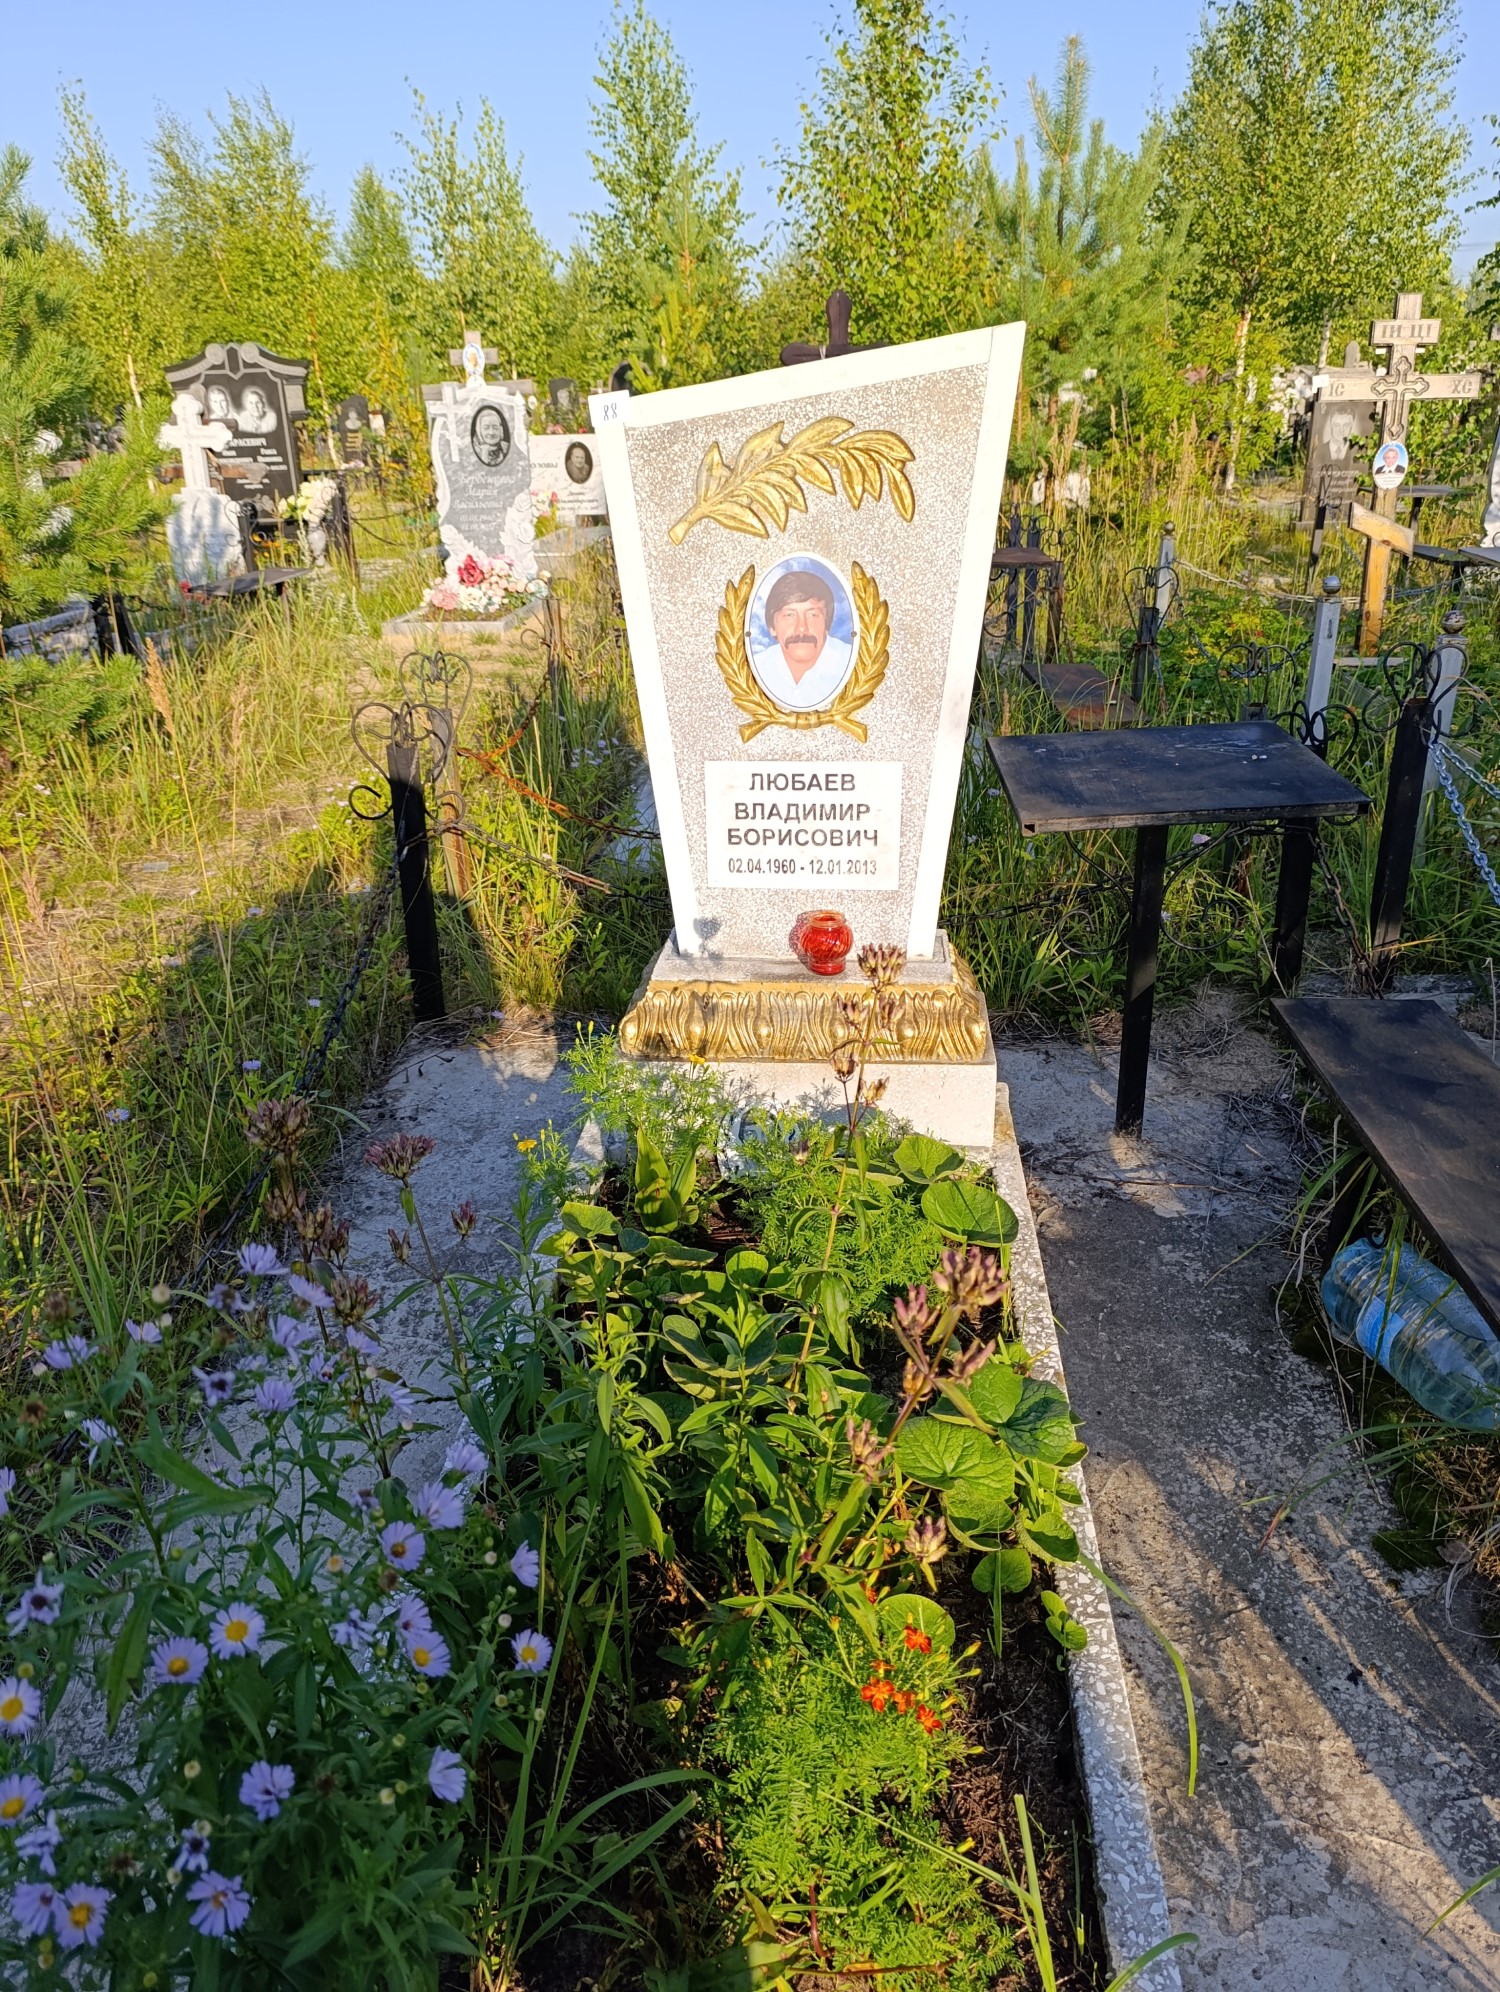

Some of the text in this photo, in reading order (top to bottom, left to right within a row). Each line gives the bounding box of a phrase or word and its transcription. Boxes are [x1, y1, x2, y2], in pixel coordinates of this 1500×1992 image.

[603, 402, 618, 421] 88
[749, 773, 855, 791] ЛЮБАЕВ
[735, 803, 870, 824] ВЛАДИМИР
[728, 828, 877, 846] БОРИСОВИЧ
[728, 858, 795, 874] 02.04.1960
[809, 860, 876, 875] 12.01.2013
